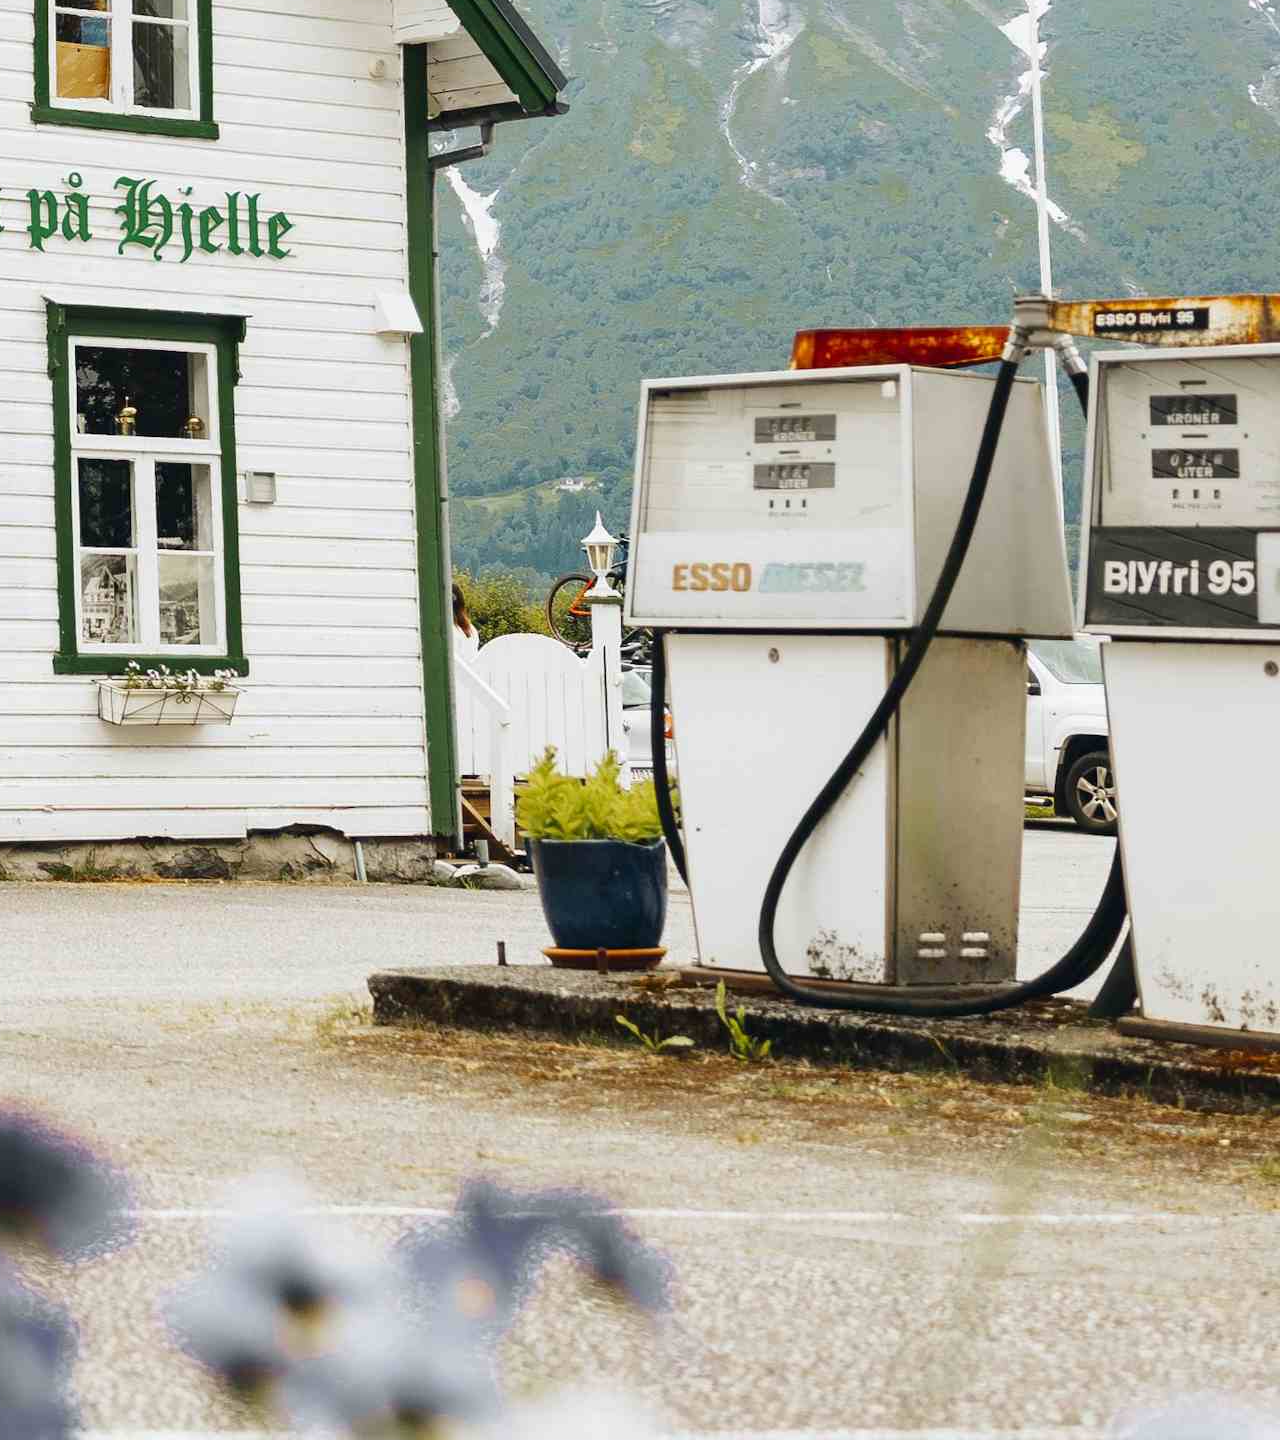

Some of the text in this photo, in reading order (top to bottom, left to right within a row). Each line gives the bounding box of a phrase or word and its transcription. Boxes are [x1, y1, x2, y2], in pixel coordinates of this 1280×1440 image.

[26, 171, 93, 252] på
[114, 176, 296, 263] Hjelle
[1096, 310, 1195, 327] ESSO Blyfri 95
[1166, 412, 1220, 424] KRONER
[1177, 466, 1214, 478] LITER
[672, 562, 753, 592] ESSO
[1104, 560, 1255, 595] Blyfri 95
